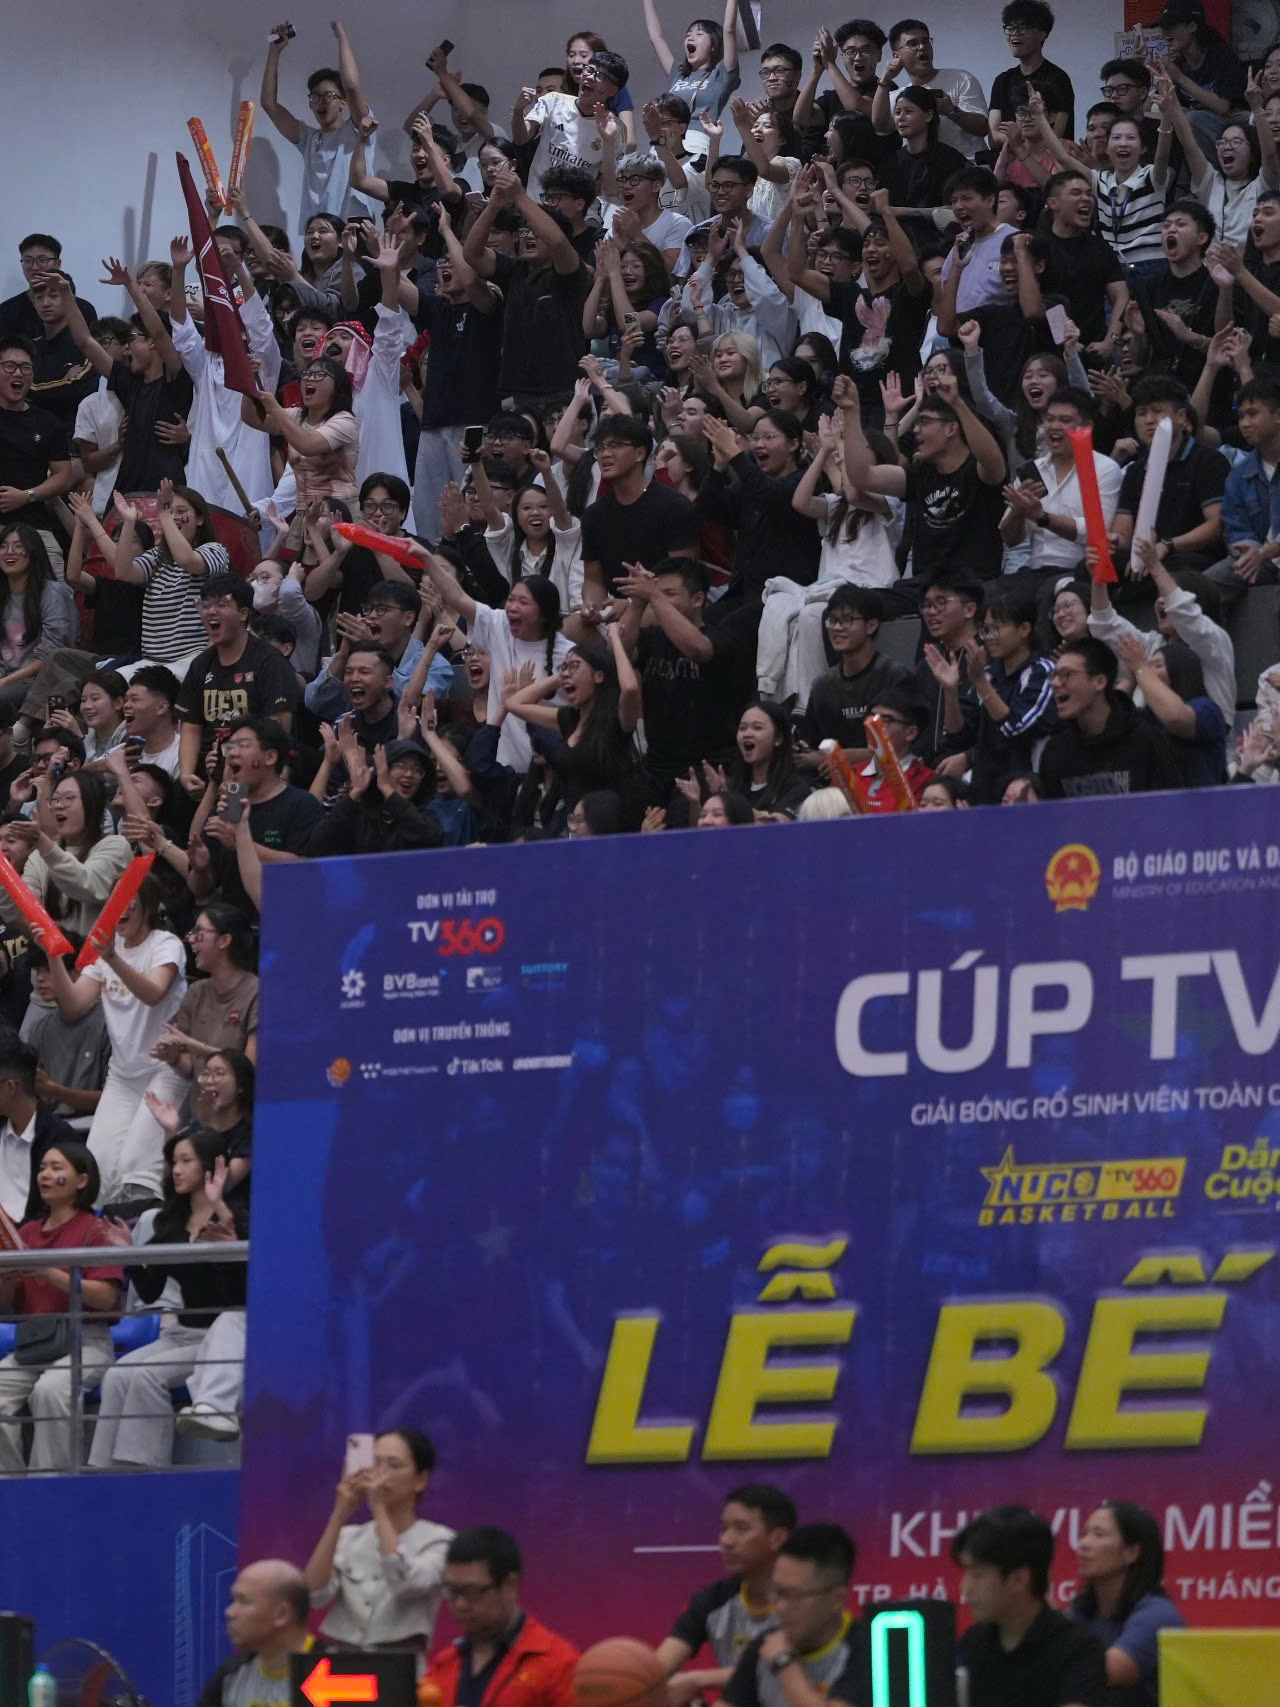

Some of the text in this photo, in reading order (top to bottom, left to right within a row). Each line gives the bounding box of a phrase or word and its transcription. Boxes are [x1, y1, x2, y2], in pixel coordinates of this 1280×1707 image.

[203, 689, 249, 722] UEB
[1113, 849, 1139, 884] BỘ
[1143, 848, 1188, 877] GIÁO
[1192, 849, 1232, 877] DỤC
[1236, 841, 1261, 870] VÀ
[407, 917, 506, 957] TV360
[383, 973, 439, 991] BVBank
[835, 949, 1095, 1078] CÚP
[461, 1058, 504, 1074] TikTok
[911, 1097, 956, 1126] GIẢI
[960, 1094, 1029, 1123] BÓNG
[1033, 1085, 1069, 1119] RỔ
[1072, 1093, 1130, 1118] SINH
[1133, 1085, 1190, 1113] VIÊN
[1194, 1081, 1264, 1110] TOÀN
[1205, 1171, 1280, 1205] Cuộ
[977, 1200, 1177, 1227] BASKETBALL
[585, 1233, 1278, 1464] LỄ BẾ
[890, 1511, 983, 1558] KH
[1163, 1480, 1280, 1552] MIỀ
